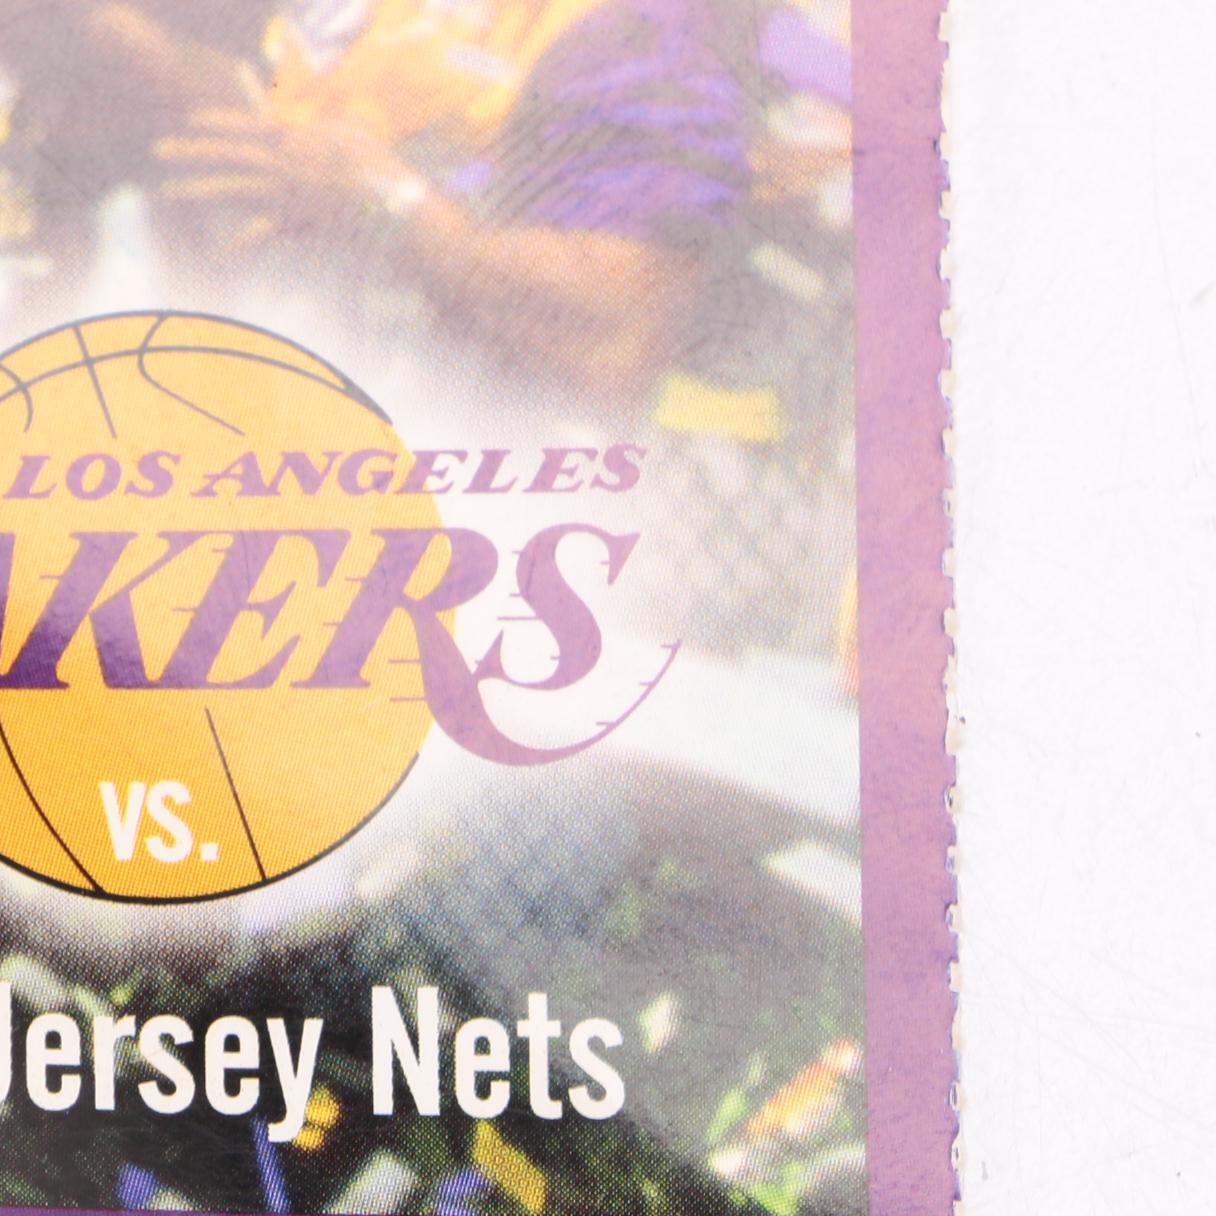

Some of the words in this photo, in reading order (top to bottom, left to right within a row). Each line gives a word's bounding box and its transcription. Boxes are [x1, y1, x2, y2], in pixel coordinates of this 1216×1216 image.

[1, 451, 182, 502] LOS
[200, 444, 650, 502] ANGELES
[101, 780, 219, 864] VS.
[371, 984, 629, 1121] Nets
